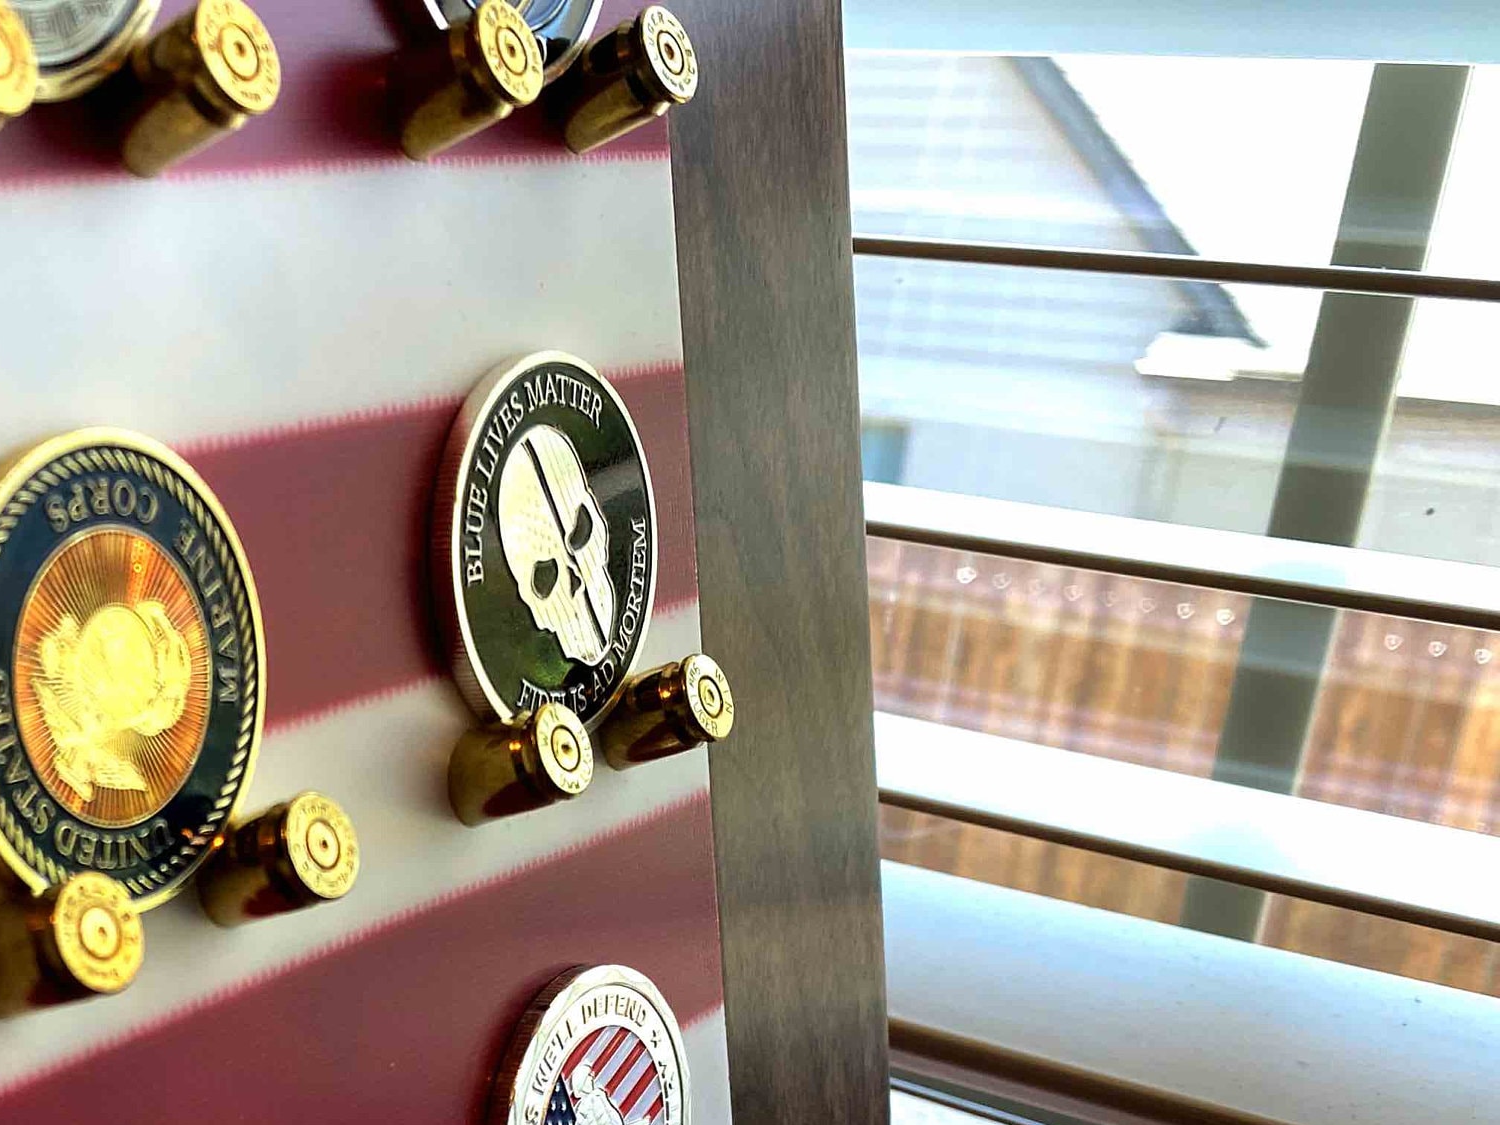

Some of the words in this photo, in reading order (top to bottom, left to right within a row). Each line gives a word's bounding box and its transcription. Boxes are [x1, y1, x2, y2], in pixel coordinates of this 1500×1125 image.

[523, 373, 604, 429] MATTER
[474, 391, 525, 484] LIVES
[44, 477, 159, 533] CORPS
[465, 483, 489, 587] BLUE
[173, 517, 243, 704] MARINE
[592, 659, 615, 702] AD
[612, 517, 647, 662] MORTEM
[690, 694, 720, 736] LUGER
[53, 817, 176, 868] UNITED
[581, 993, 647, 1028] DEFEND
